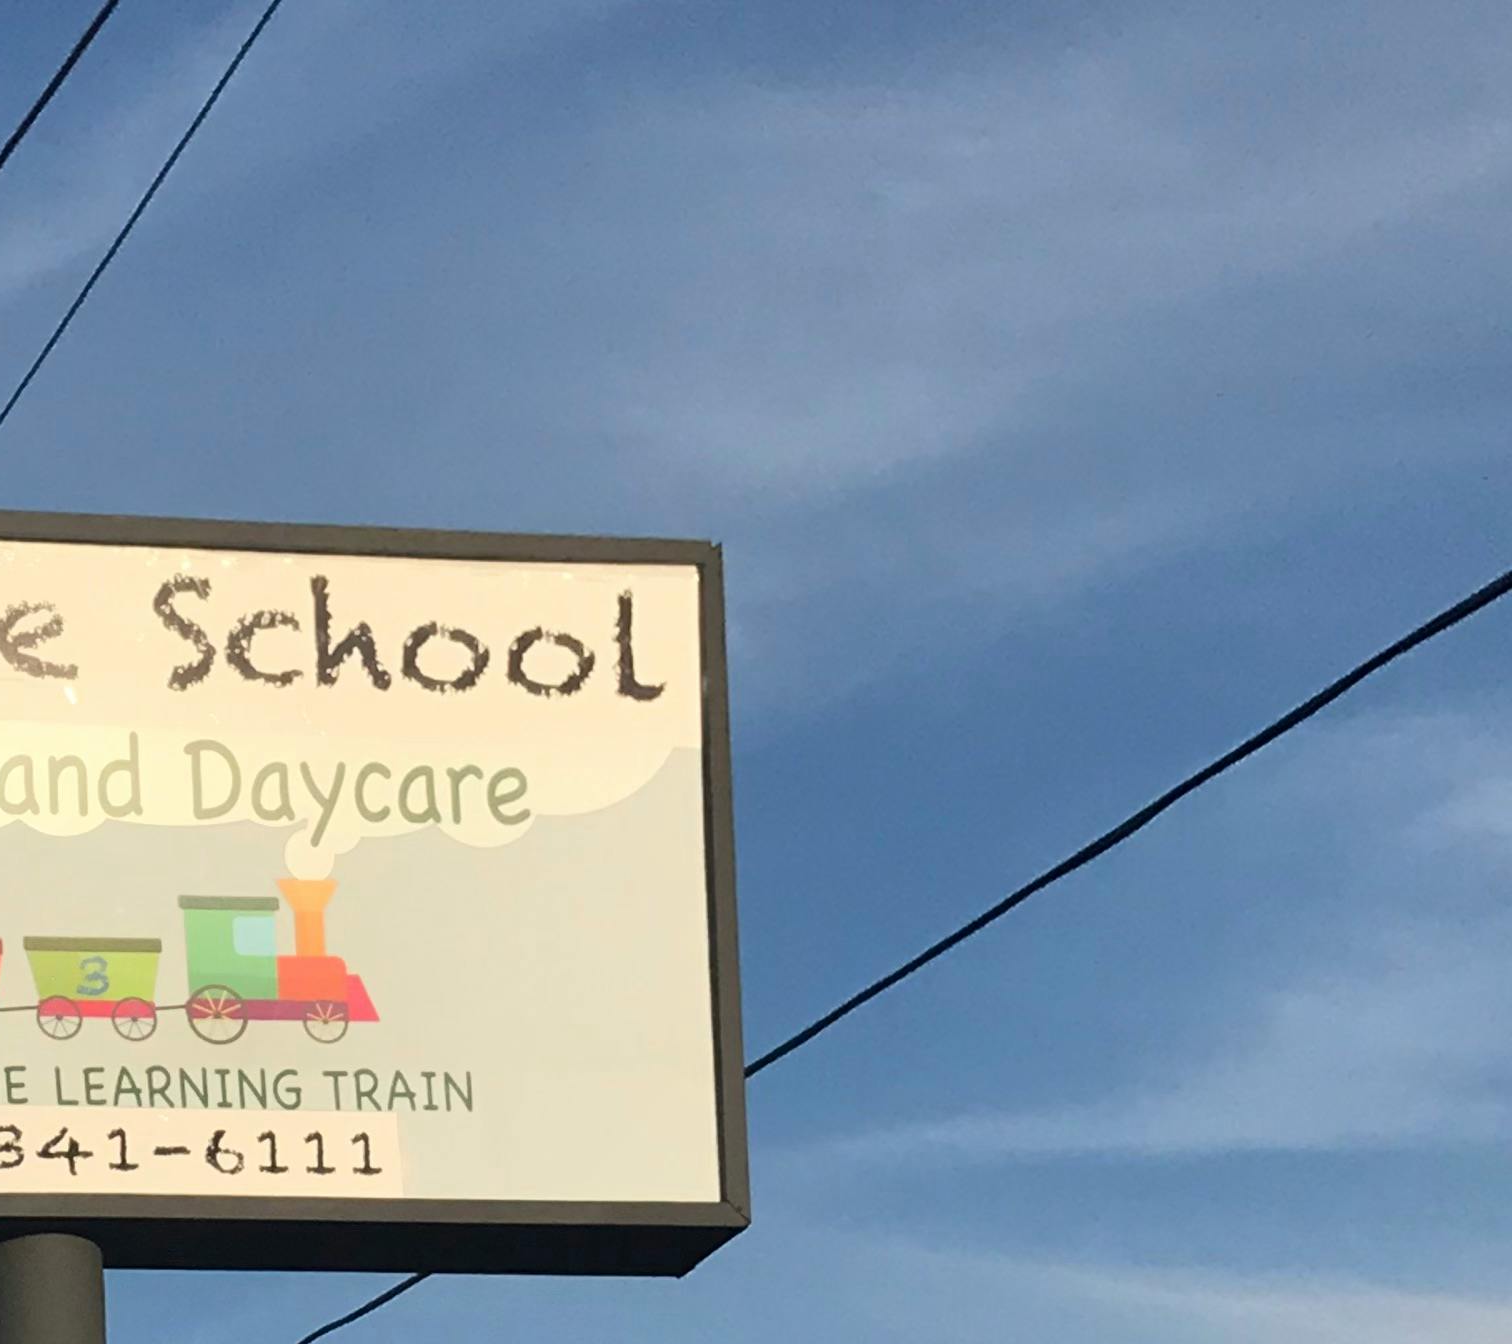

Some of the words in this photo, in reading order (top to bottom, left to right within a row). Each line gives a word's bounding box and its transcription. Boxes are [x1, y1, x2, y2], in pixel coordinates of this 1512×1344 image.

[153, 573, 667, 701] School
[183, 738, 532, 848] Daycare
[75, 956, 110, 997] 3
[54, 1065, 303, 1111] LEARNING
[323, 1069, 475, 1114] TRAIN
